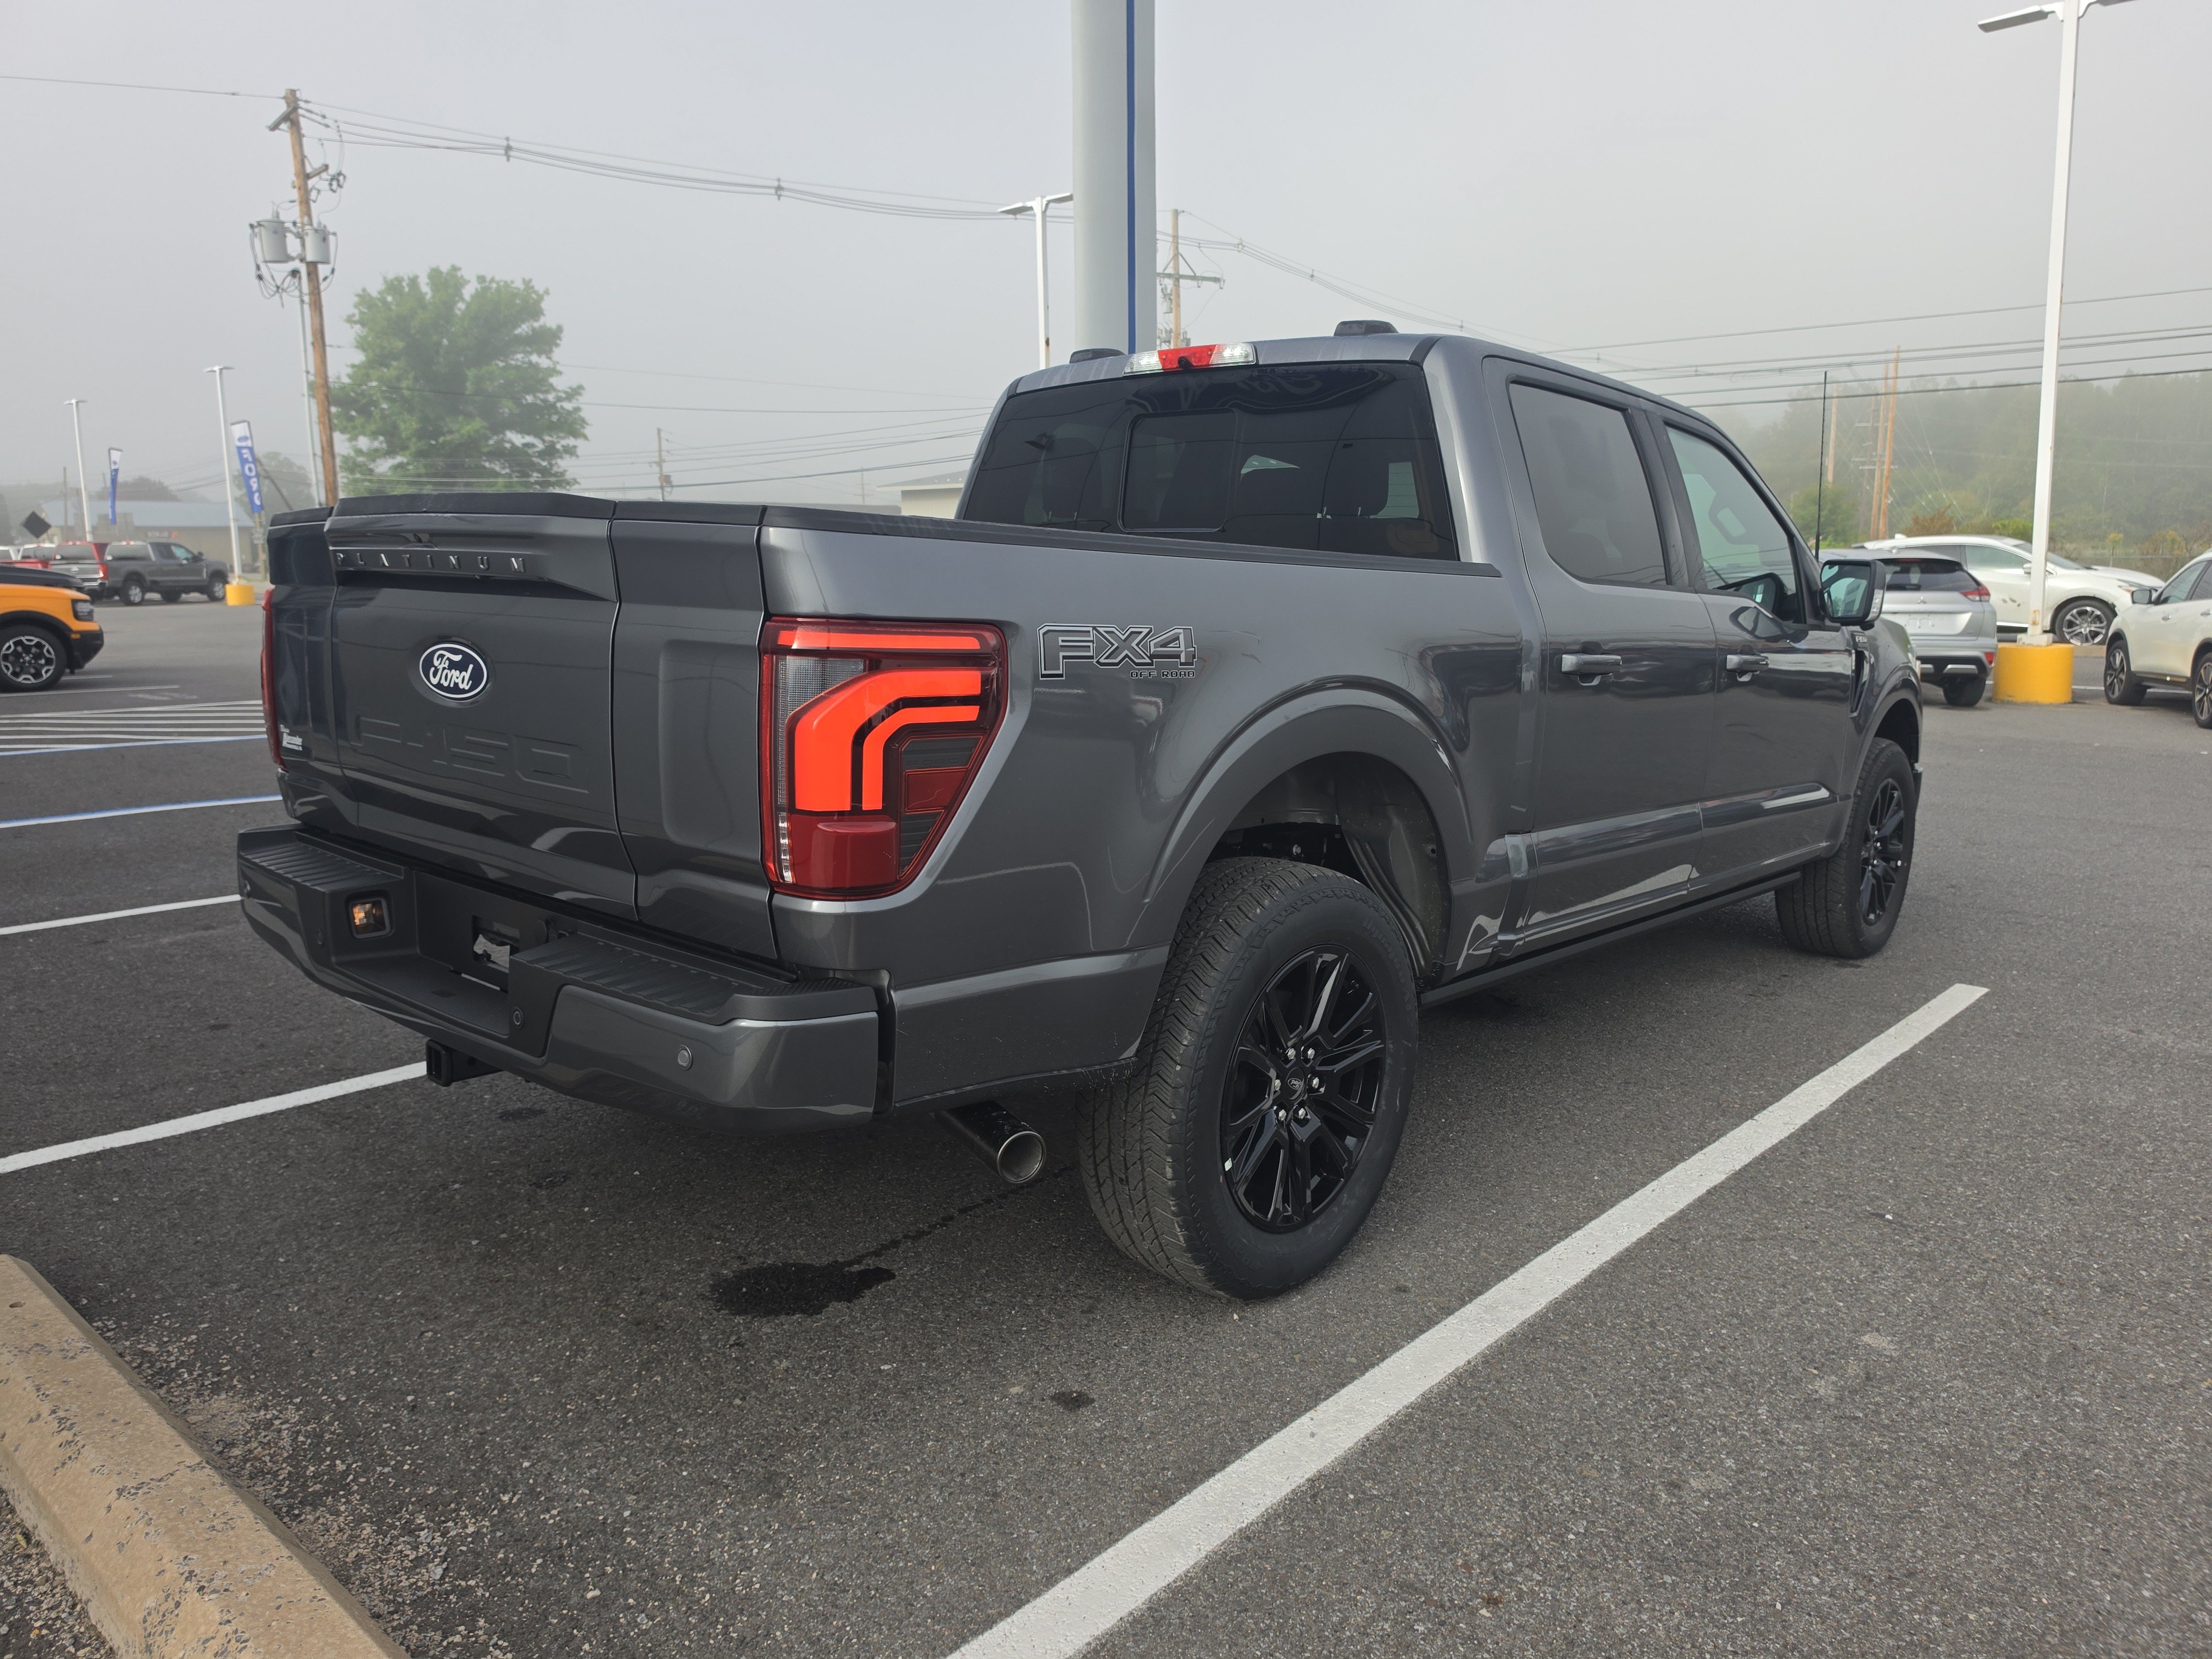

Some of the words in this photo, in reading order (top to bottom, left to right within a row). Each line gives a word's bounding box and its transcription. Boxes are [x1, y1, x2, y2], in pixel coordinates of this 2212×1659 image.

[336, 552, 525, 573] PLATINUM
[1037, 623, 1197, 680] FX4
[429, 650, 474, 690] Ford
[1130, 670, 1157, 679] OFF
[1161, 670, 1195, 679] ROAD
